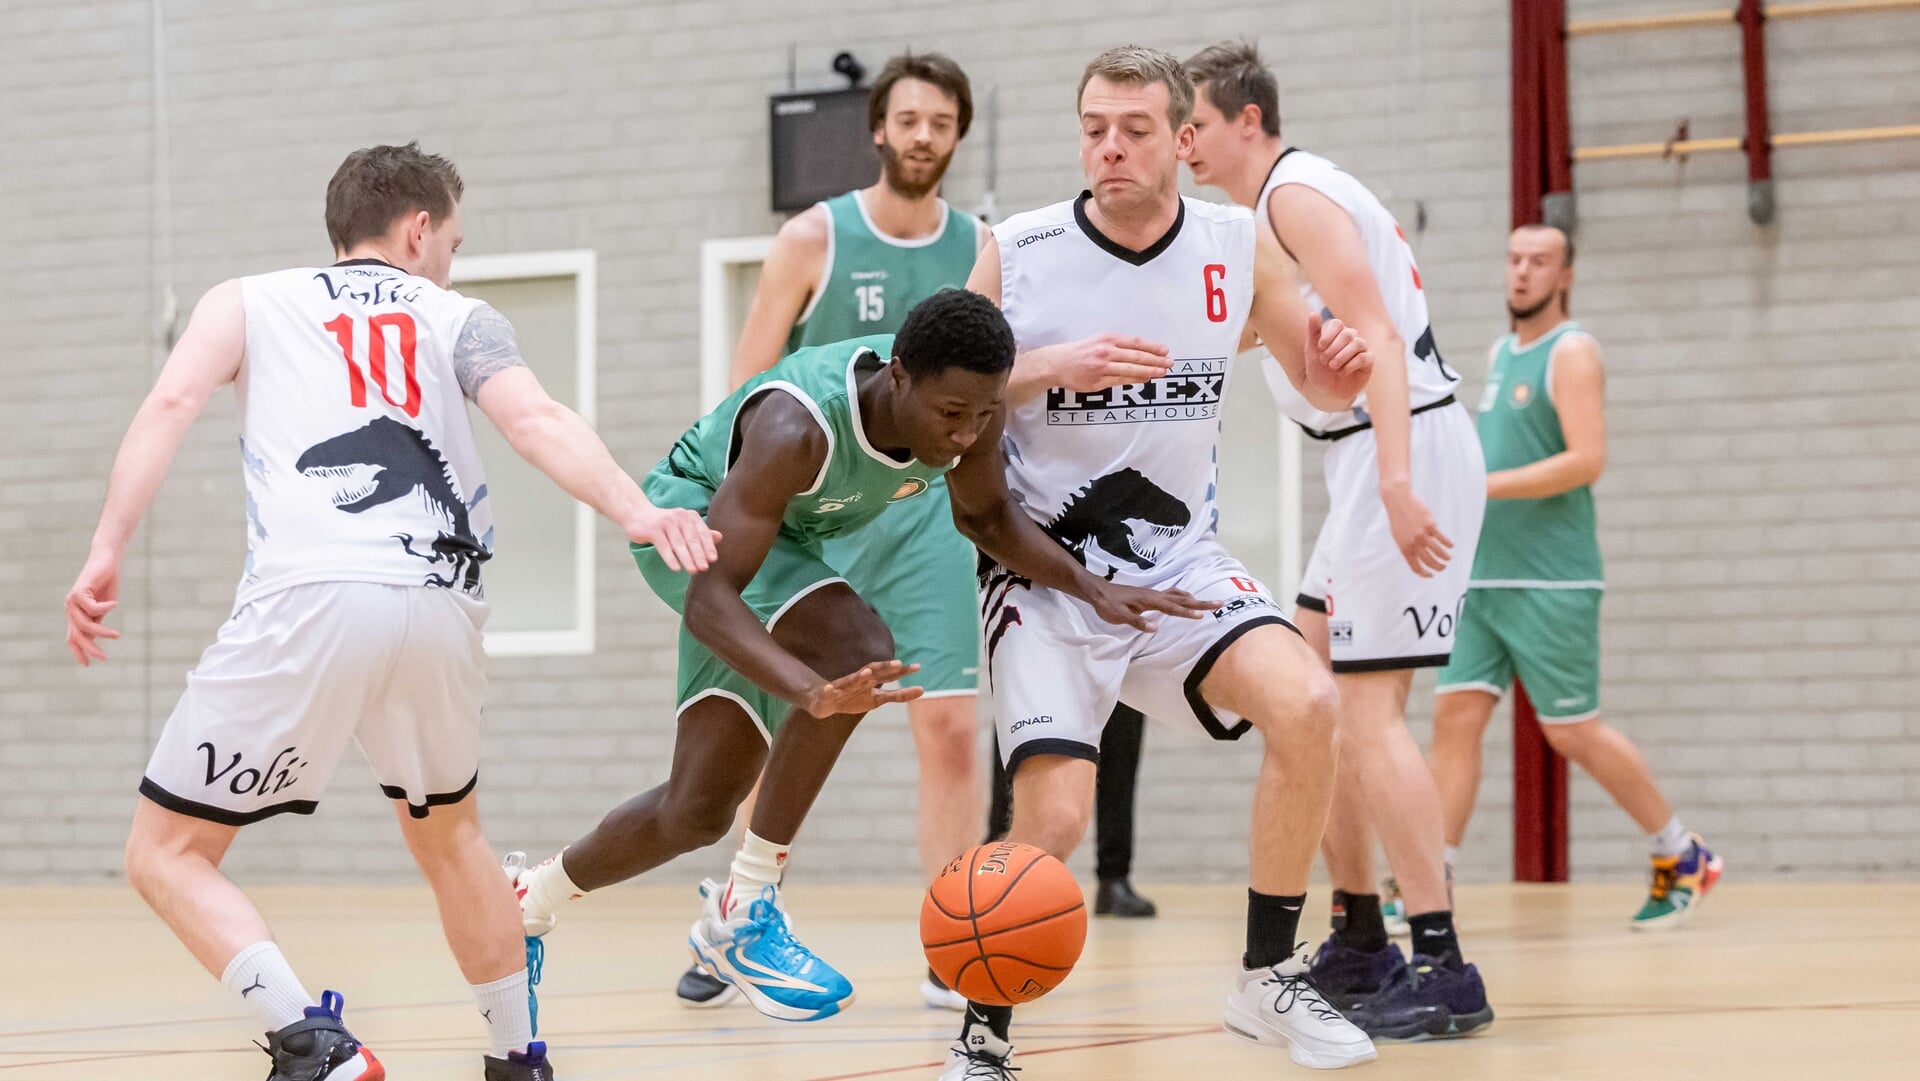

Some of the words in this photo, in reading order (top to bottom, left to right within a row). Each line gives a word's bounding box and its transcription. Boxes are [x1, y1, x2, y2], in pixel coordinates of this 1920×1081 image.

[1016, 227, 1066, 249] DONACI
[855, 285, 885, 322] 15
[1203, 264, 1228, 323] 6
[323, 312, 422, 418] 10
[1051, 375, 1224, 409] T-REX
[1051, 404, 1218, 423] STEAKHOUSE
[1010, 715, 1053, 734] DONACI
[971, 1035, 986, 1045] 23
